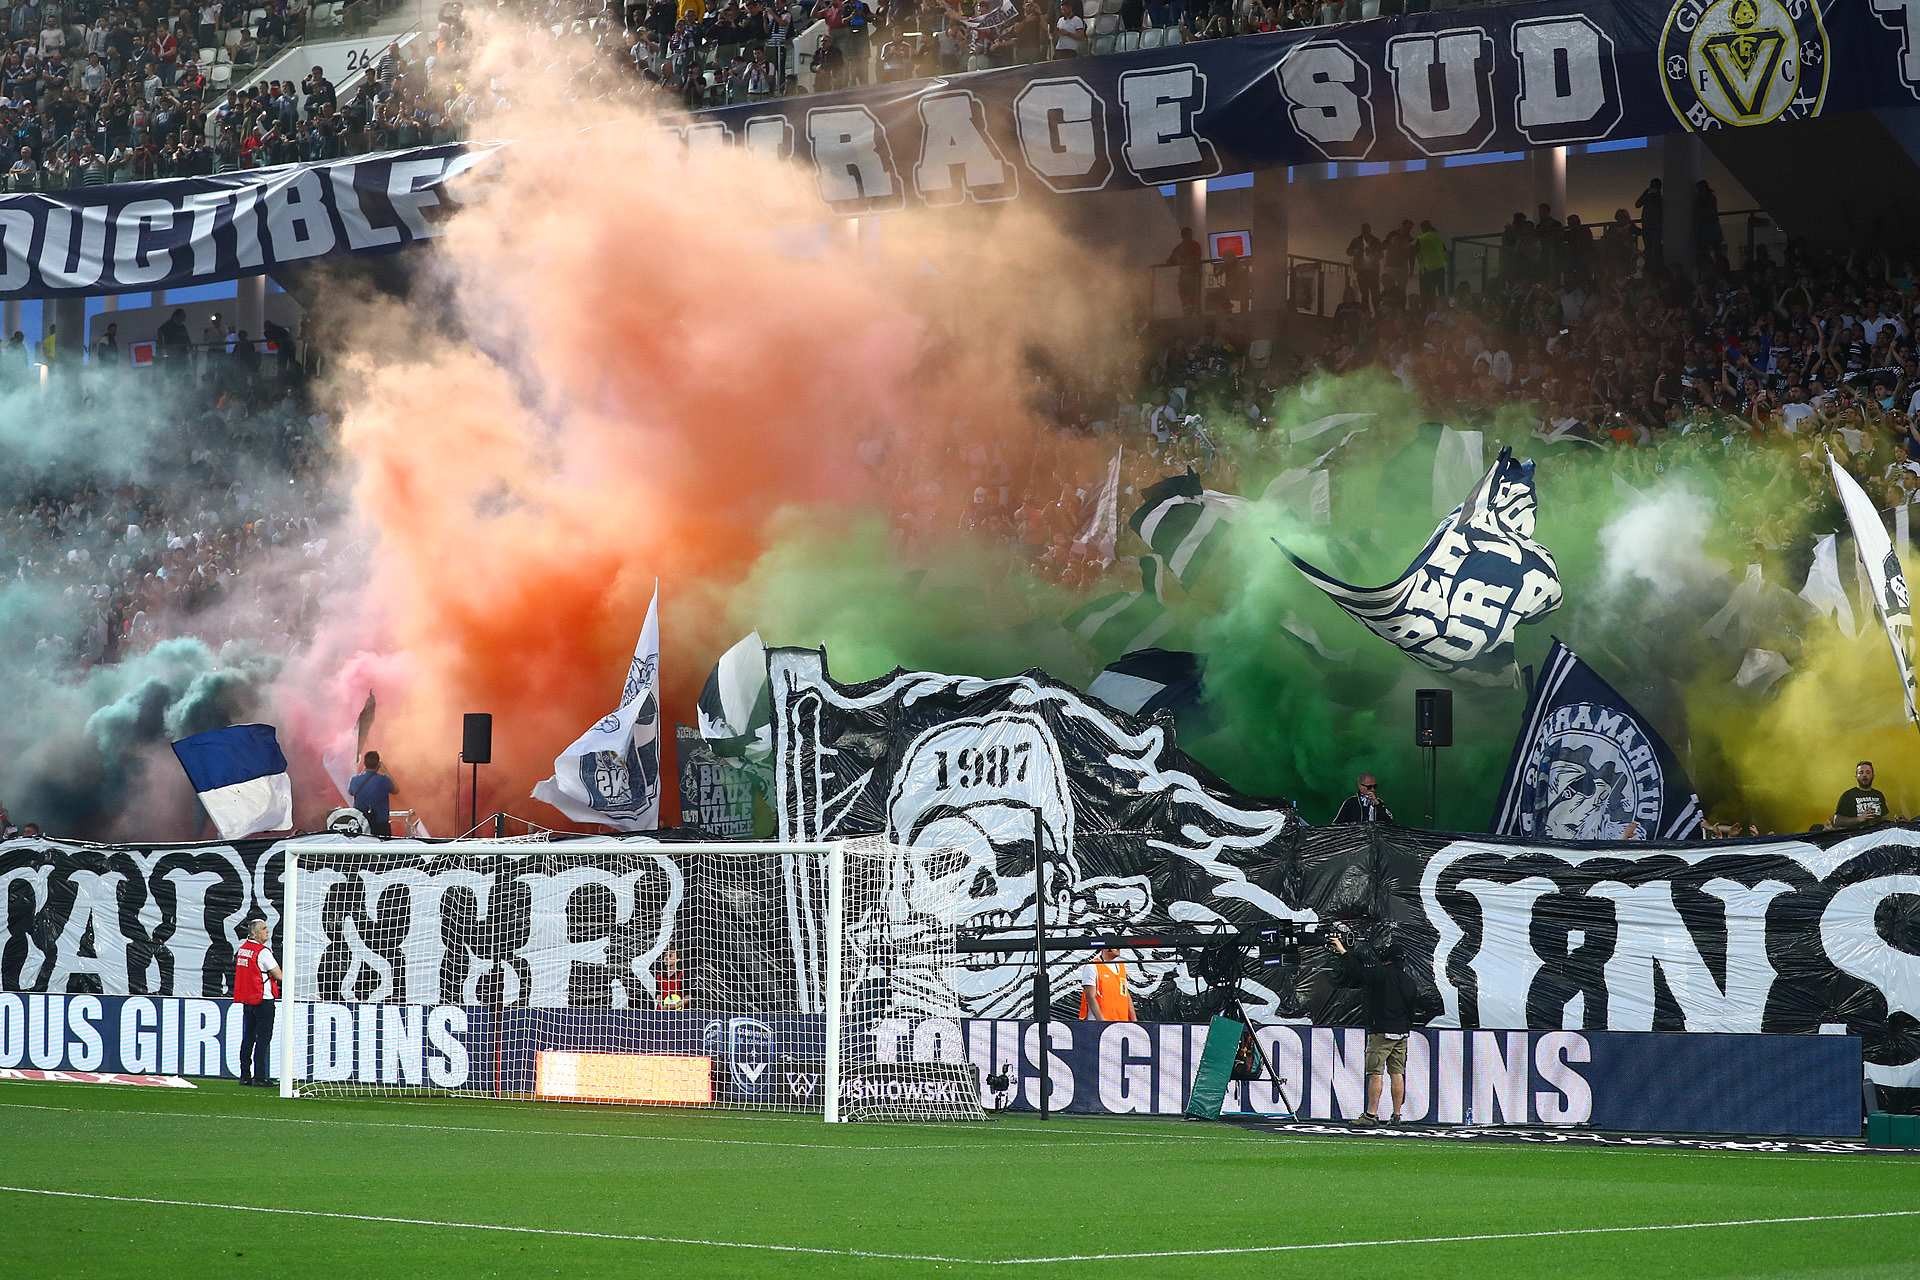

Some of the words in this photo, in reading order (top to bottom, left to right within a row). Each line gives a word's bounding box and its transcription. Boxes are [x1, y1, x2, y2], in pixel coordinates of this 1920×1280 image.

[347, 48, 369, 70] 26
[647, 66, 1213, 208] IRAGE
[1279, 18, 1616, 150] SUD
[934, 741, 1031, 791] 1987
[700, 801, 752, 824] VILLE
[838, 1075, 957, 1101] IŚNIOWSKI
[1099, 1021, 1592, 1124] GIONDINS
